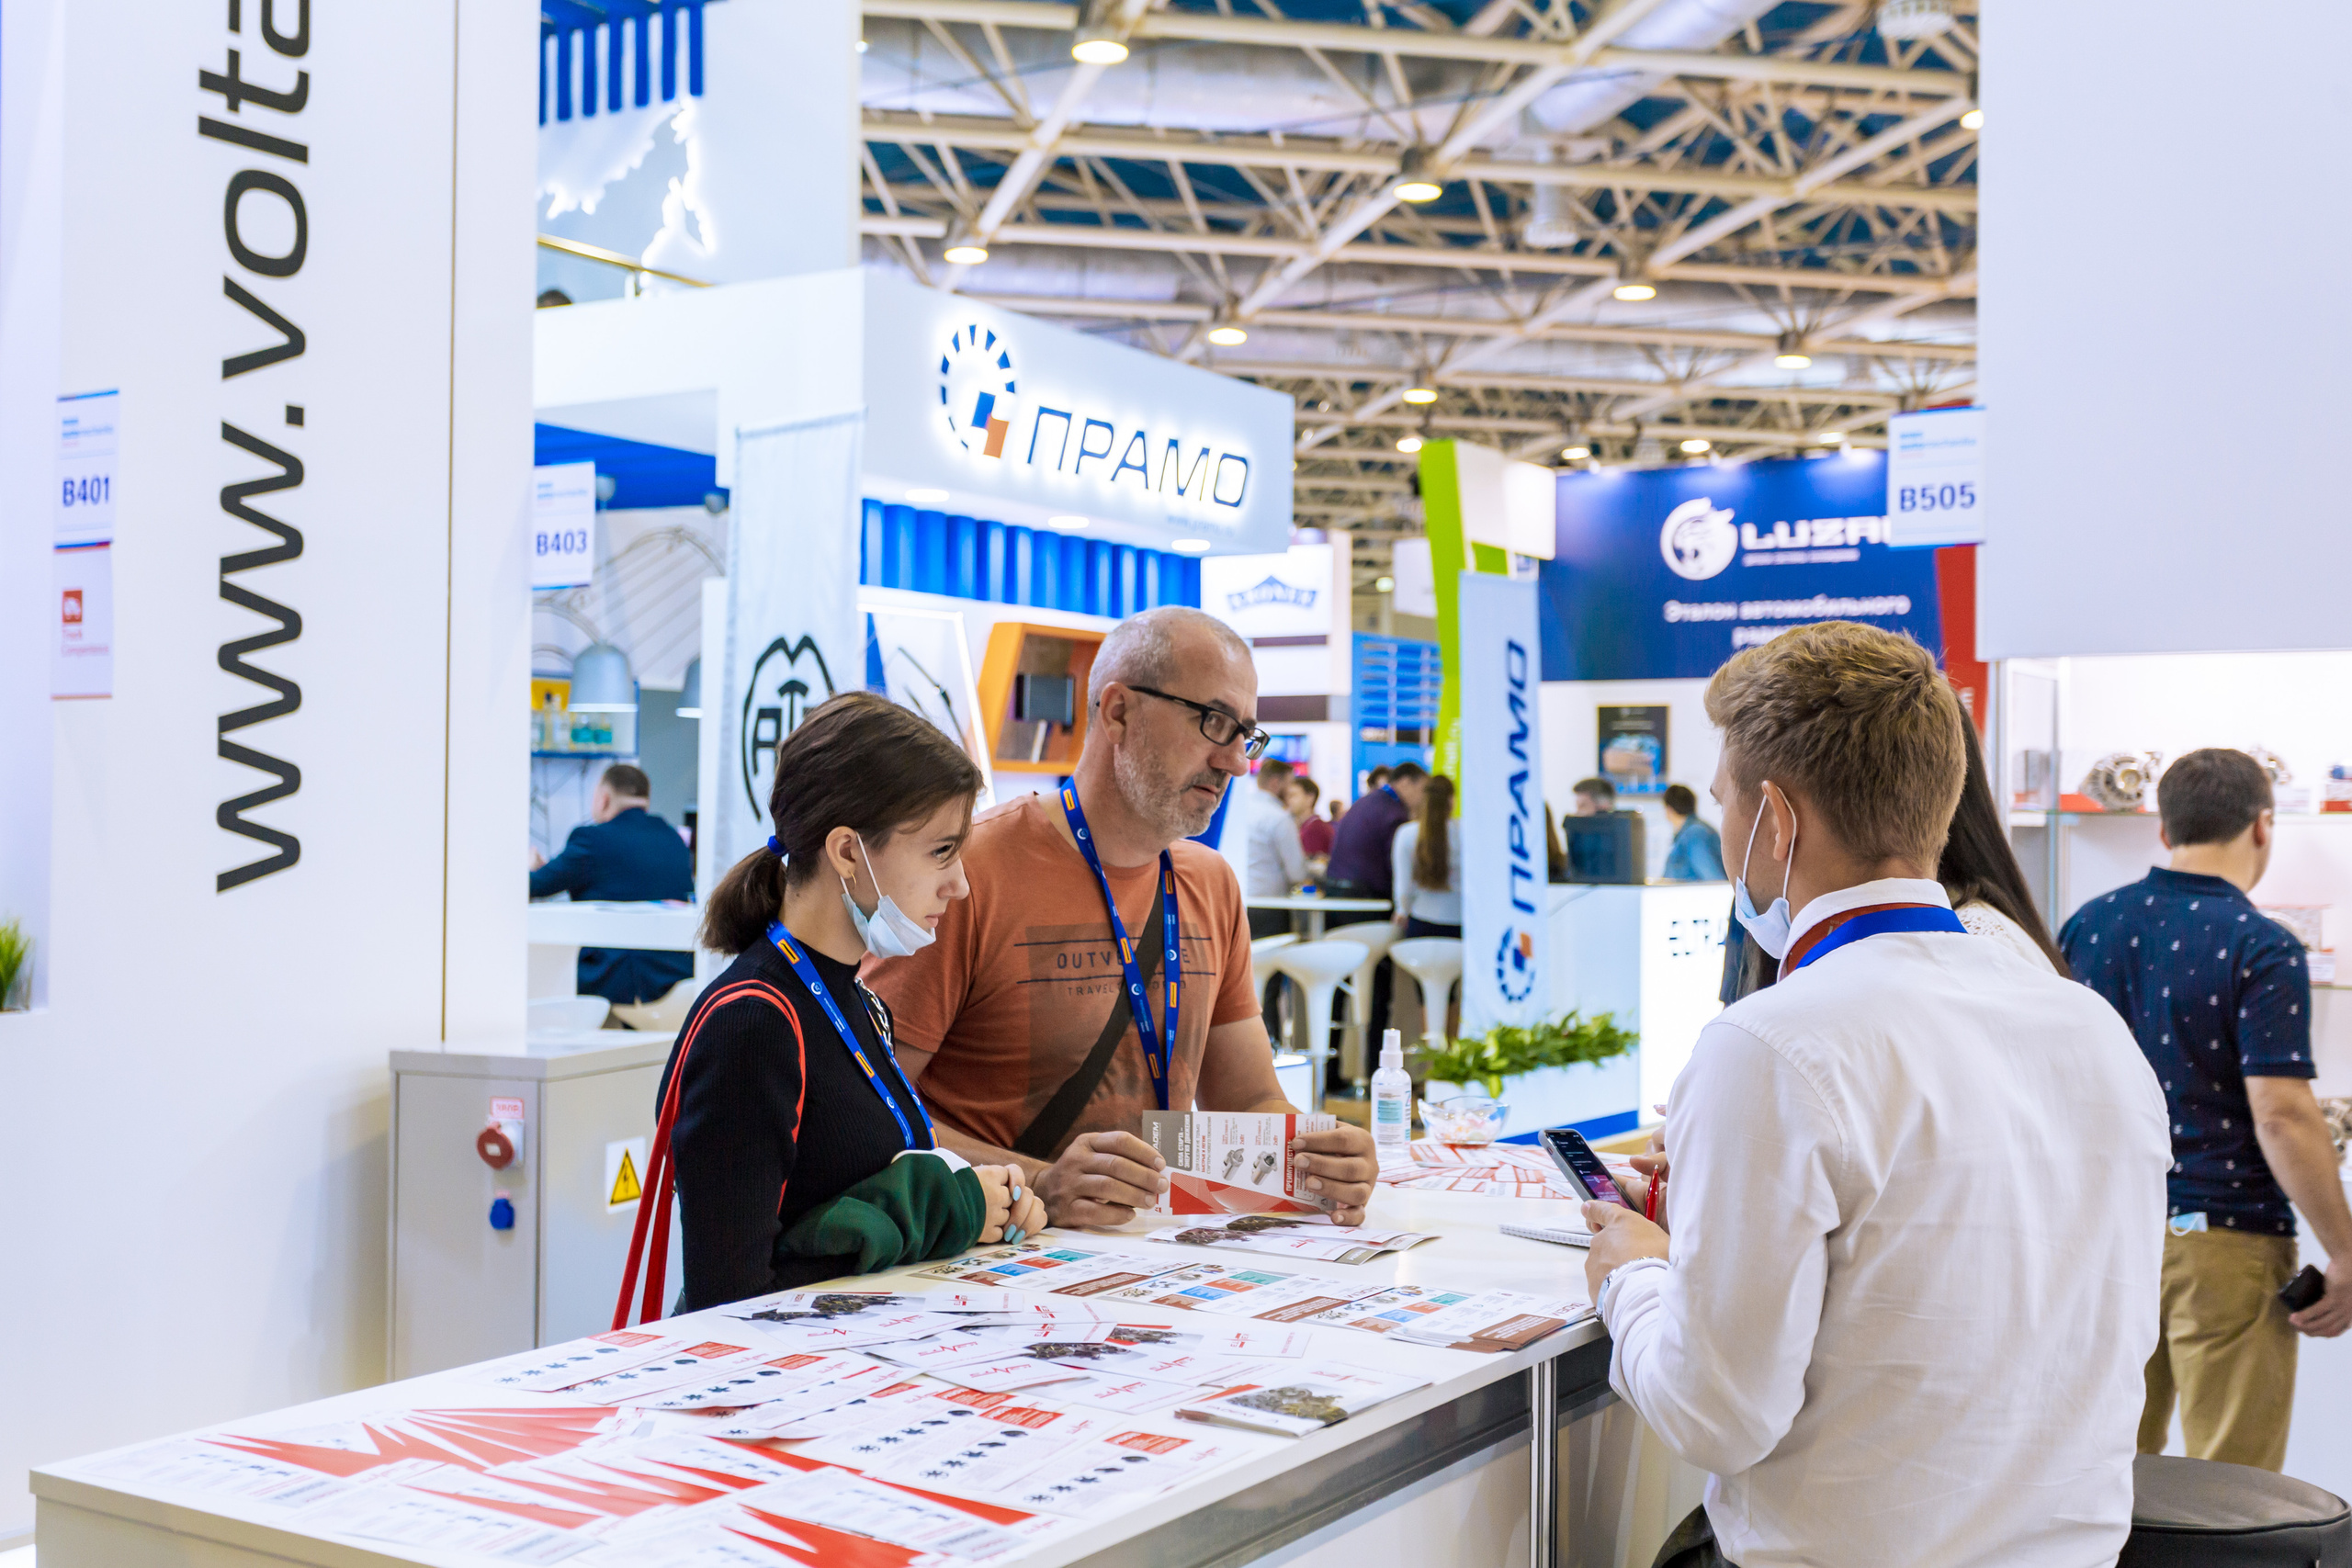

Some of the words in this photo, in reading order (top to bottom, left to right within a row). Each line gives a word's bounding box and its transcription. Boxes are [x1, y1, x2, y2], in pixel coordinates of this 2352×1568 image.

[1027, 405, 1249, 508] ПРАМО
[62, 475, 110, 507] B401
[1900, 483, 1975, 513] B505
[537, 521, 588, 557] B403
[1741, 515, 1891, 550] LUZA
[1506, 637, 1535, 914] ПРАМО
[1057, 948, 1191, 969] OUTVEE
[1067, 983, 1114, 998] TRAVEL
